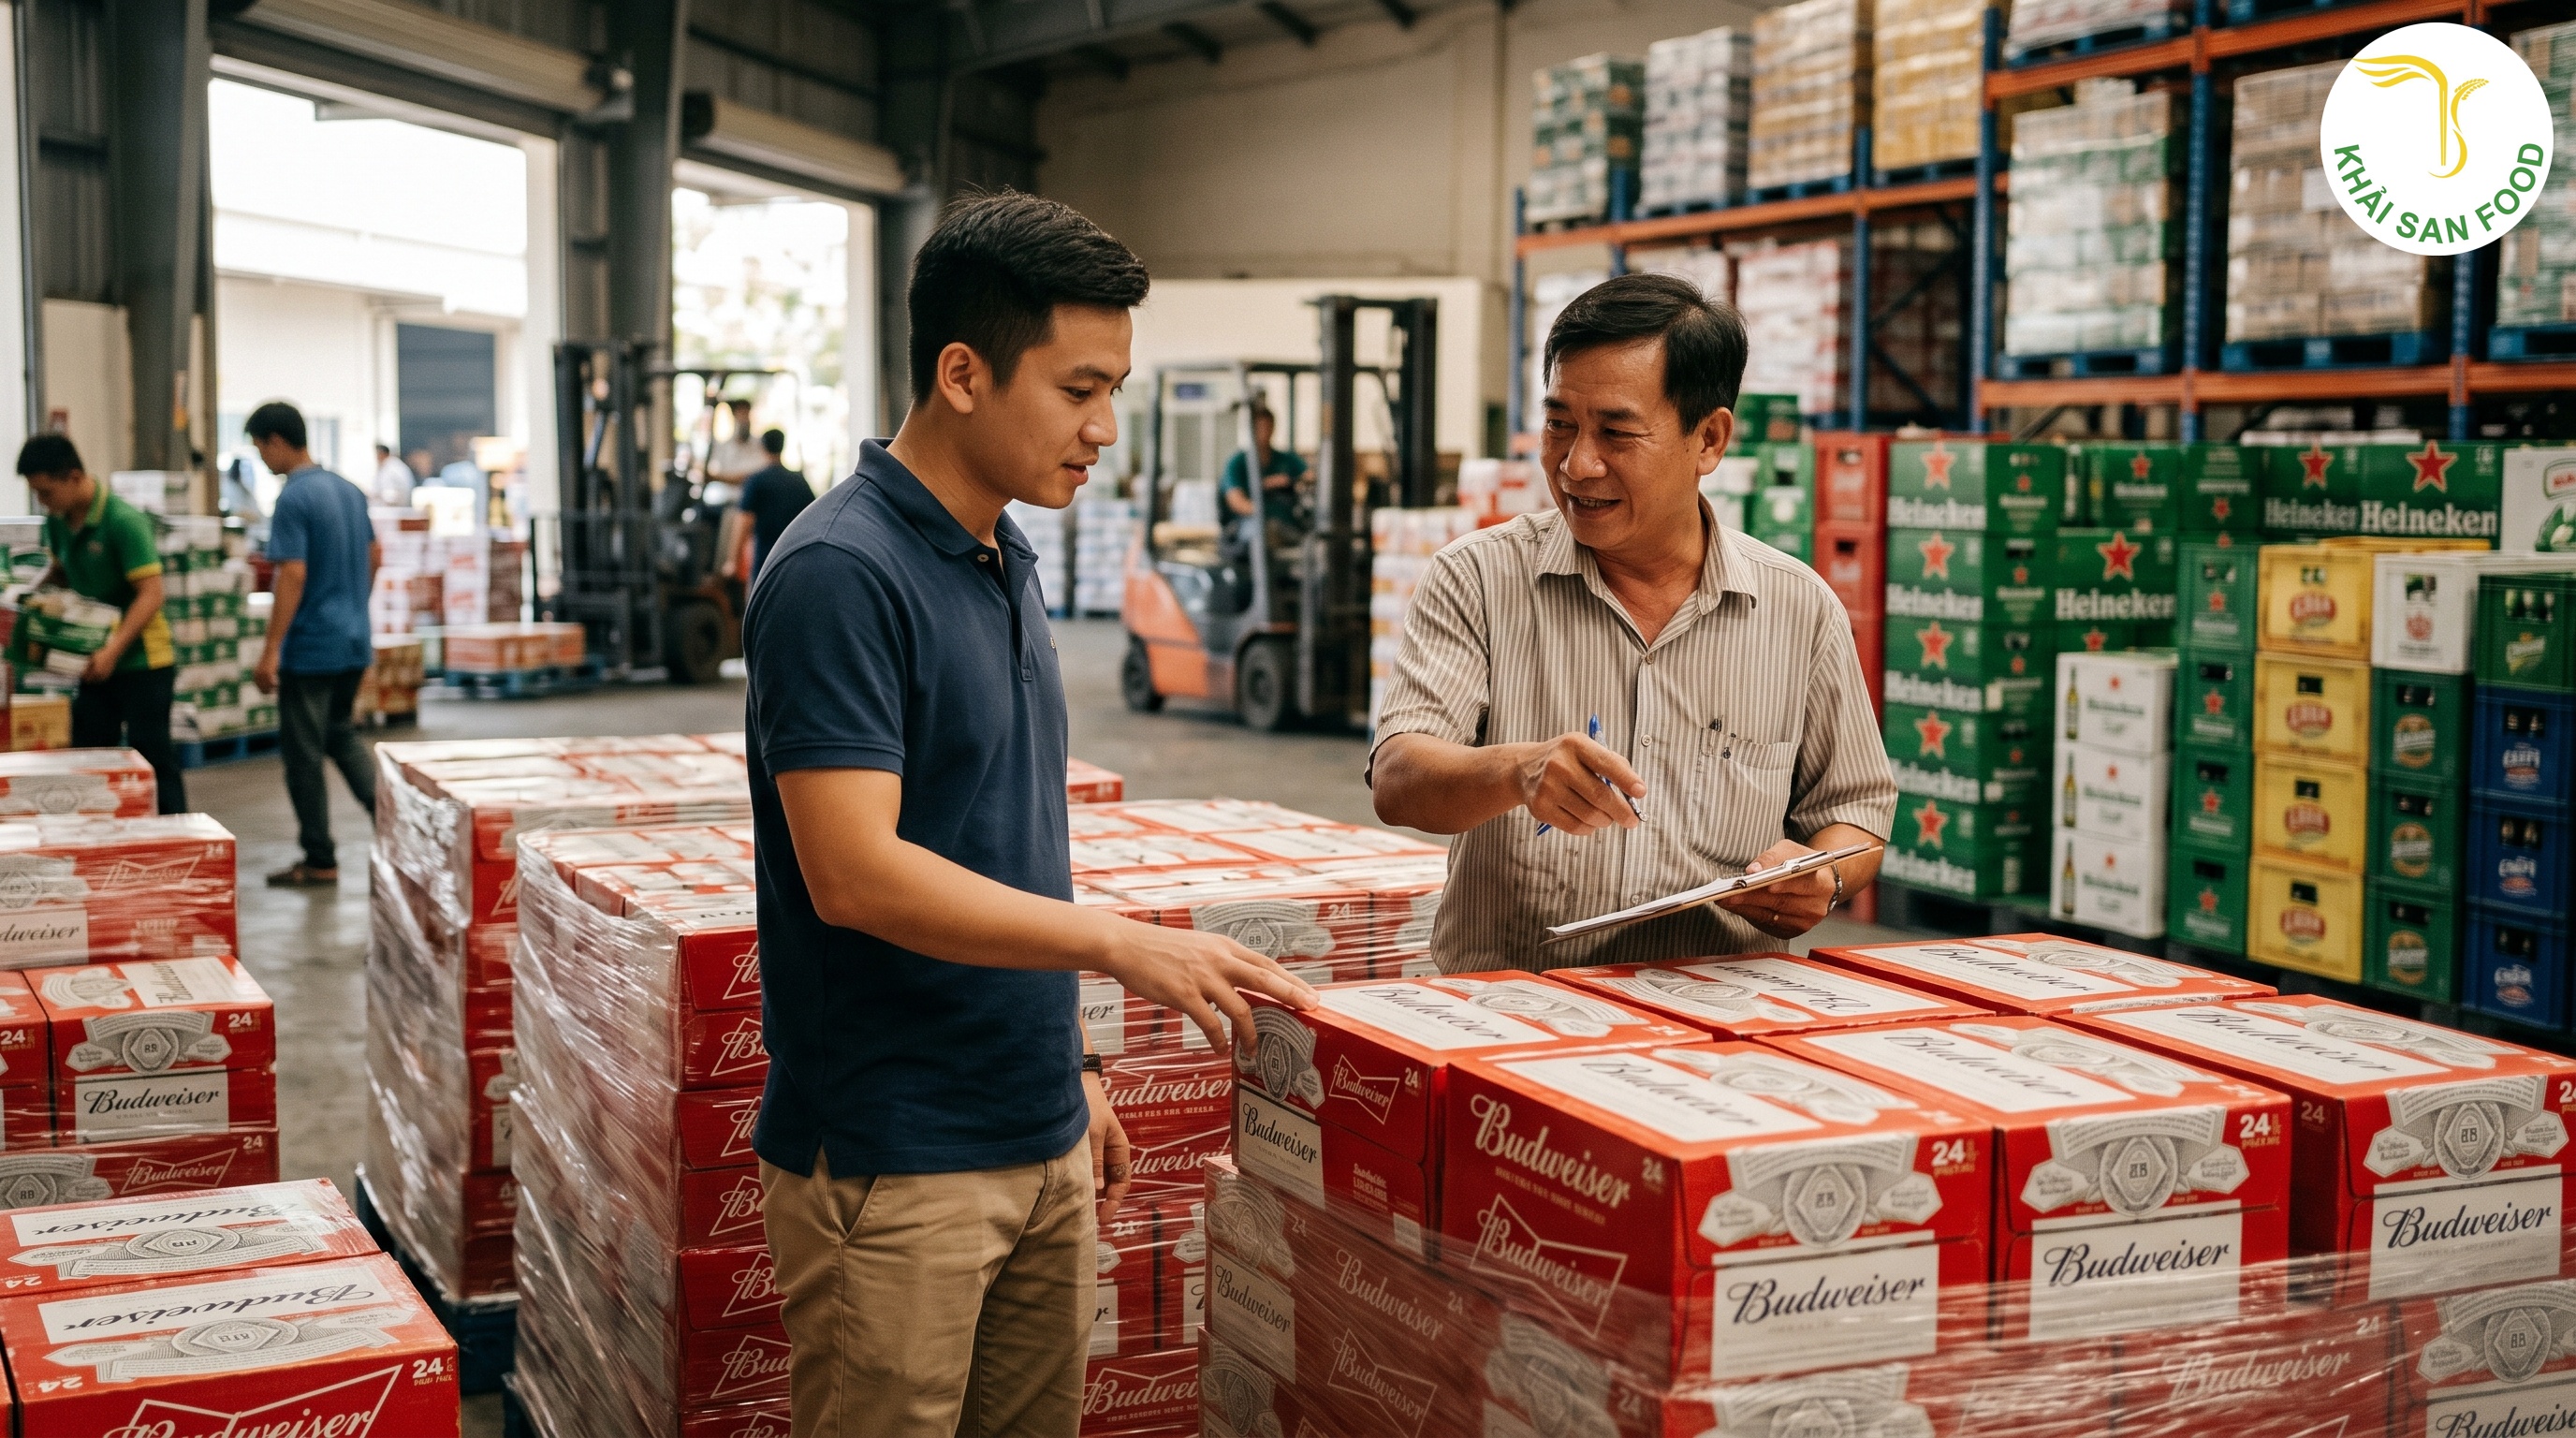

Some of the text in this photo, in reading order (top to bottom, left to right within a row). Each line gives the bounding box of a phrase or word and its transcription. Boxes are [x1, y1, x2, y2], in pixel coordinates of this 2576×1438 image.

[2360, 499, 2497, 536] Heineken
[1328, 903, 1350, 920] 24
[0, 923, 80, 942] dweiser
[227, 1012, 253, 1028] 24
[1, 1030, 25, 1045] 24
[1333, 1064, 1390, 1108] Budweiser
[1405, 1067, 1419, 1088] 24
[84, 1088, 219, 1114] Budweiser
[2559, 1080, 2576, 1104] 2
[2240, 1112, 2272, 1138] 24
[2301, 1101, 2325, 1123] 24
[243, 1136, 263, 1150] 24
[1243, 1102, 1317, 1165] Budweiser
[1471, 1093, 1631, 1209] Budweiser
[1932, 1139, 1966, 1167] 24
[127, 1162, 225, 1186] Budweiser
[1643, 1157, 1663, 1183] 24
[2383, 1202, 2552, 1249] Budweiser
[1477, 1209, 1610, 1308] Budweiser
[2043, 1240, 2230, 1287] Budweiser
[6, 1275, 42, 1289] 24
[1337, 1249, 1443, 1341] Budweiser
[64, 1284, 374, 1331] Budweiser
[1215, 1265, 1291, 1332] Budweiser
[1728, 1273, 1926, 1325] Budweiser
[2355, 1315, 2380, 1336] 24
[412, 1357, 444, 1380] 24
[1333, 1337, 1425, 1421] Budweiser
[2162, 1348, 2351, 1406] Budweiser
[38, 1376, 82, 1393] 24
[1084, 1373, 1198, 1416] Budwei
